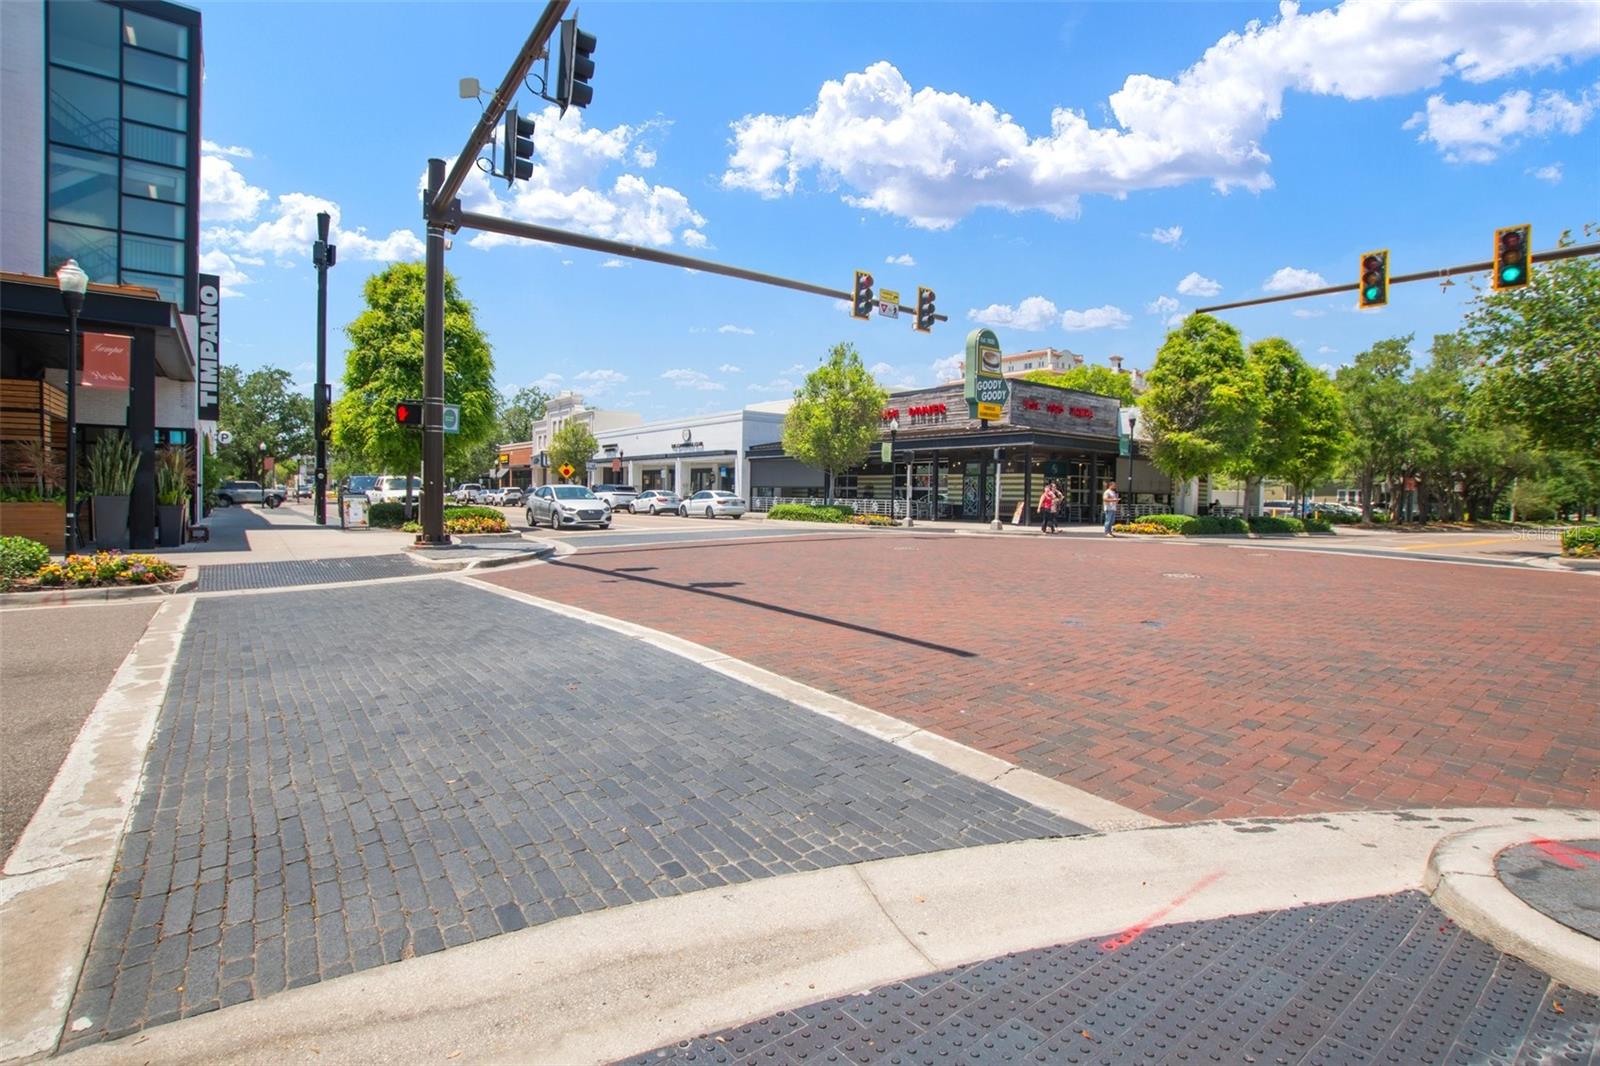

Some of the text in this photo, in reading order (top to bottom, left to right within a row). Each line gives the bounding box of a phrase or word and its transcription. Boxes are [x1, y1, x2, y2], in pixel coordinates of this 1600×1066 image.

[200, 285, 218, 408] TIMPANO
[977, 380, 1002, 390] GOODY
[981, 391, 1007, 401] GOODY
[221, 433, 229, 441] P
